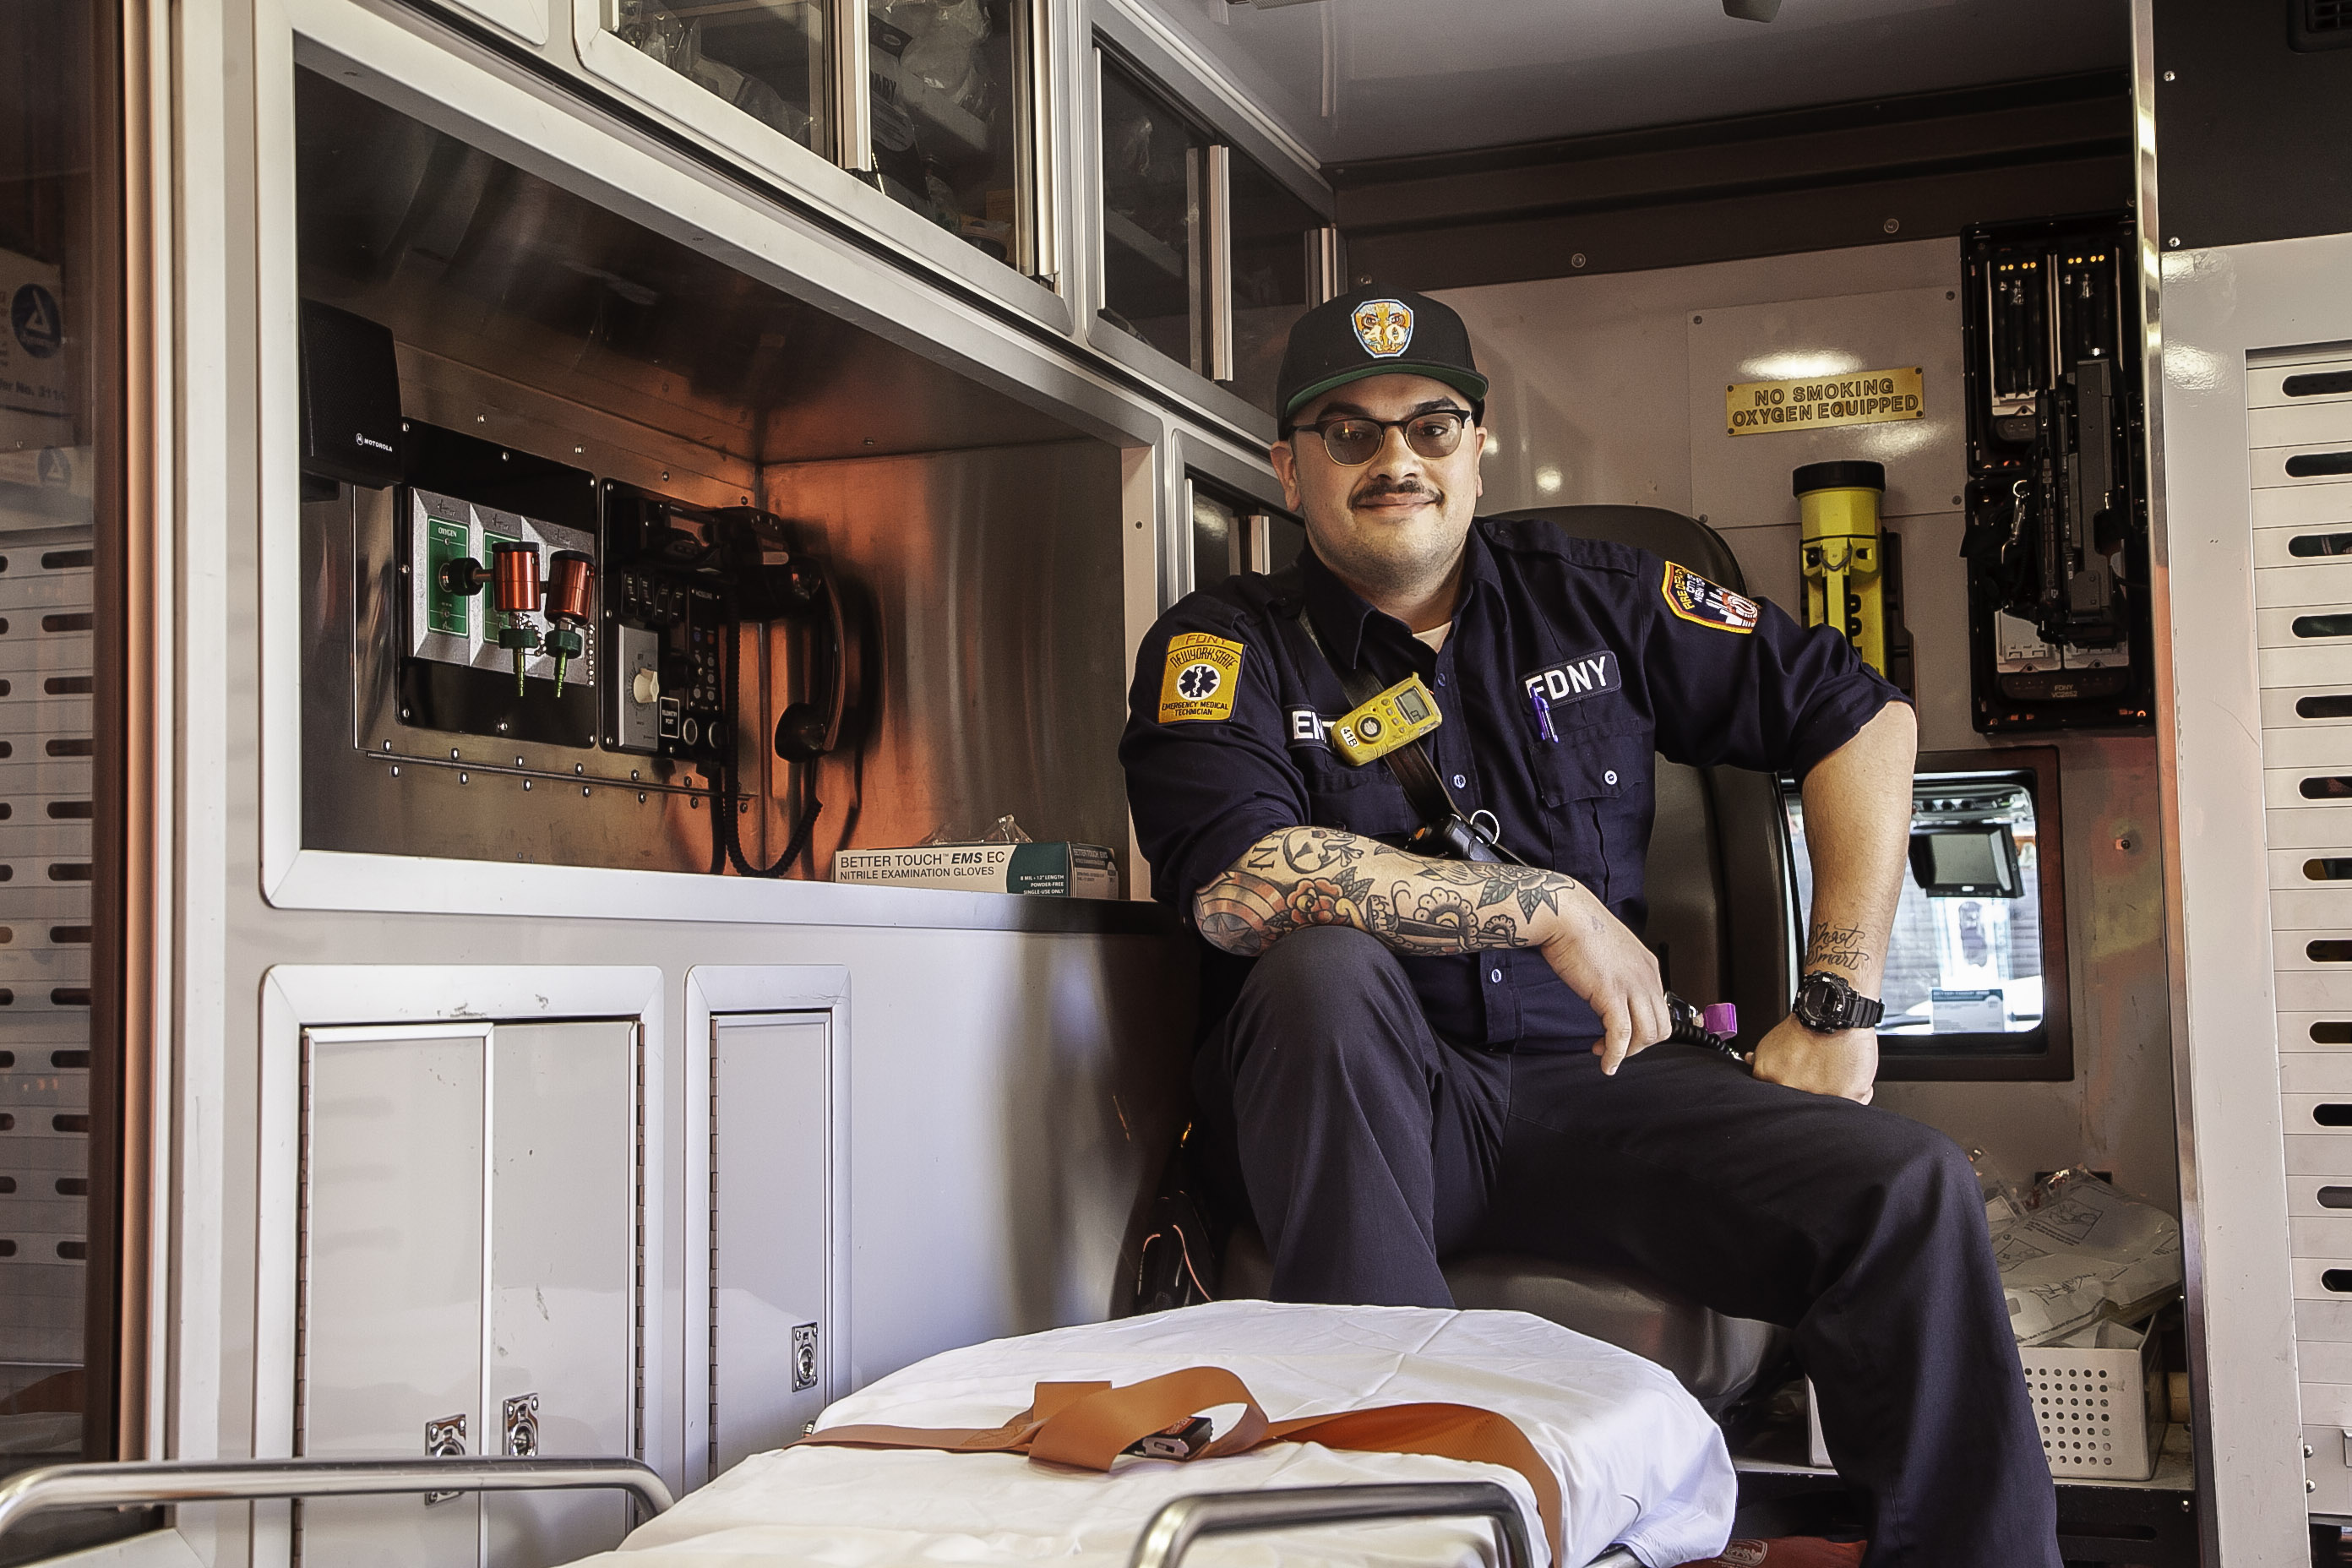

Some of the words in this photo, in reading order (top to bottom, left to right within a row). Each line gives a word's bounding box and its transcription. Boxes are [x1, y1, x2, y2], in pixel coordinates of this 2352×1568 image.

[1755, 389, 1785, 406] NO
[1793, 378, 1894, 402] SMOKING
[1733, 405, 1812, 427] OXYGEN
[1818, 395, 1919, 419] EQUIPPED
[364, 438, 393, 453] MOTOROLA
[1677, 590, 1695, 610] FIRE
[1185, 634, 1228, 645] FDNY
[1169, 651, 1190, 668] NEW
[1190, 647, 1213, 662] YORK
[1212, 650, 1239, 670] STATE
[1524, 656, 1607, 700] FDNY
[1162, 702, 1198, 710] EMERGENCY
[1200, 701, 1228, 710] MEDICAL
[1343, 728, 1358, 747] 41B
[841, 855, 892, 868] BETTER
[951, 852, 983, 863] EMS
[987, 851, 1005, 863] EC
[840, 868, 879, 880] NITRILE
[881, 868, 950, 879] EXAMINATION
[953, 866, 994, 876] GLOVES
